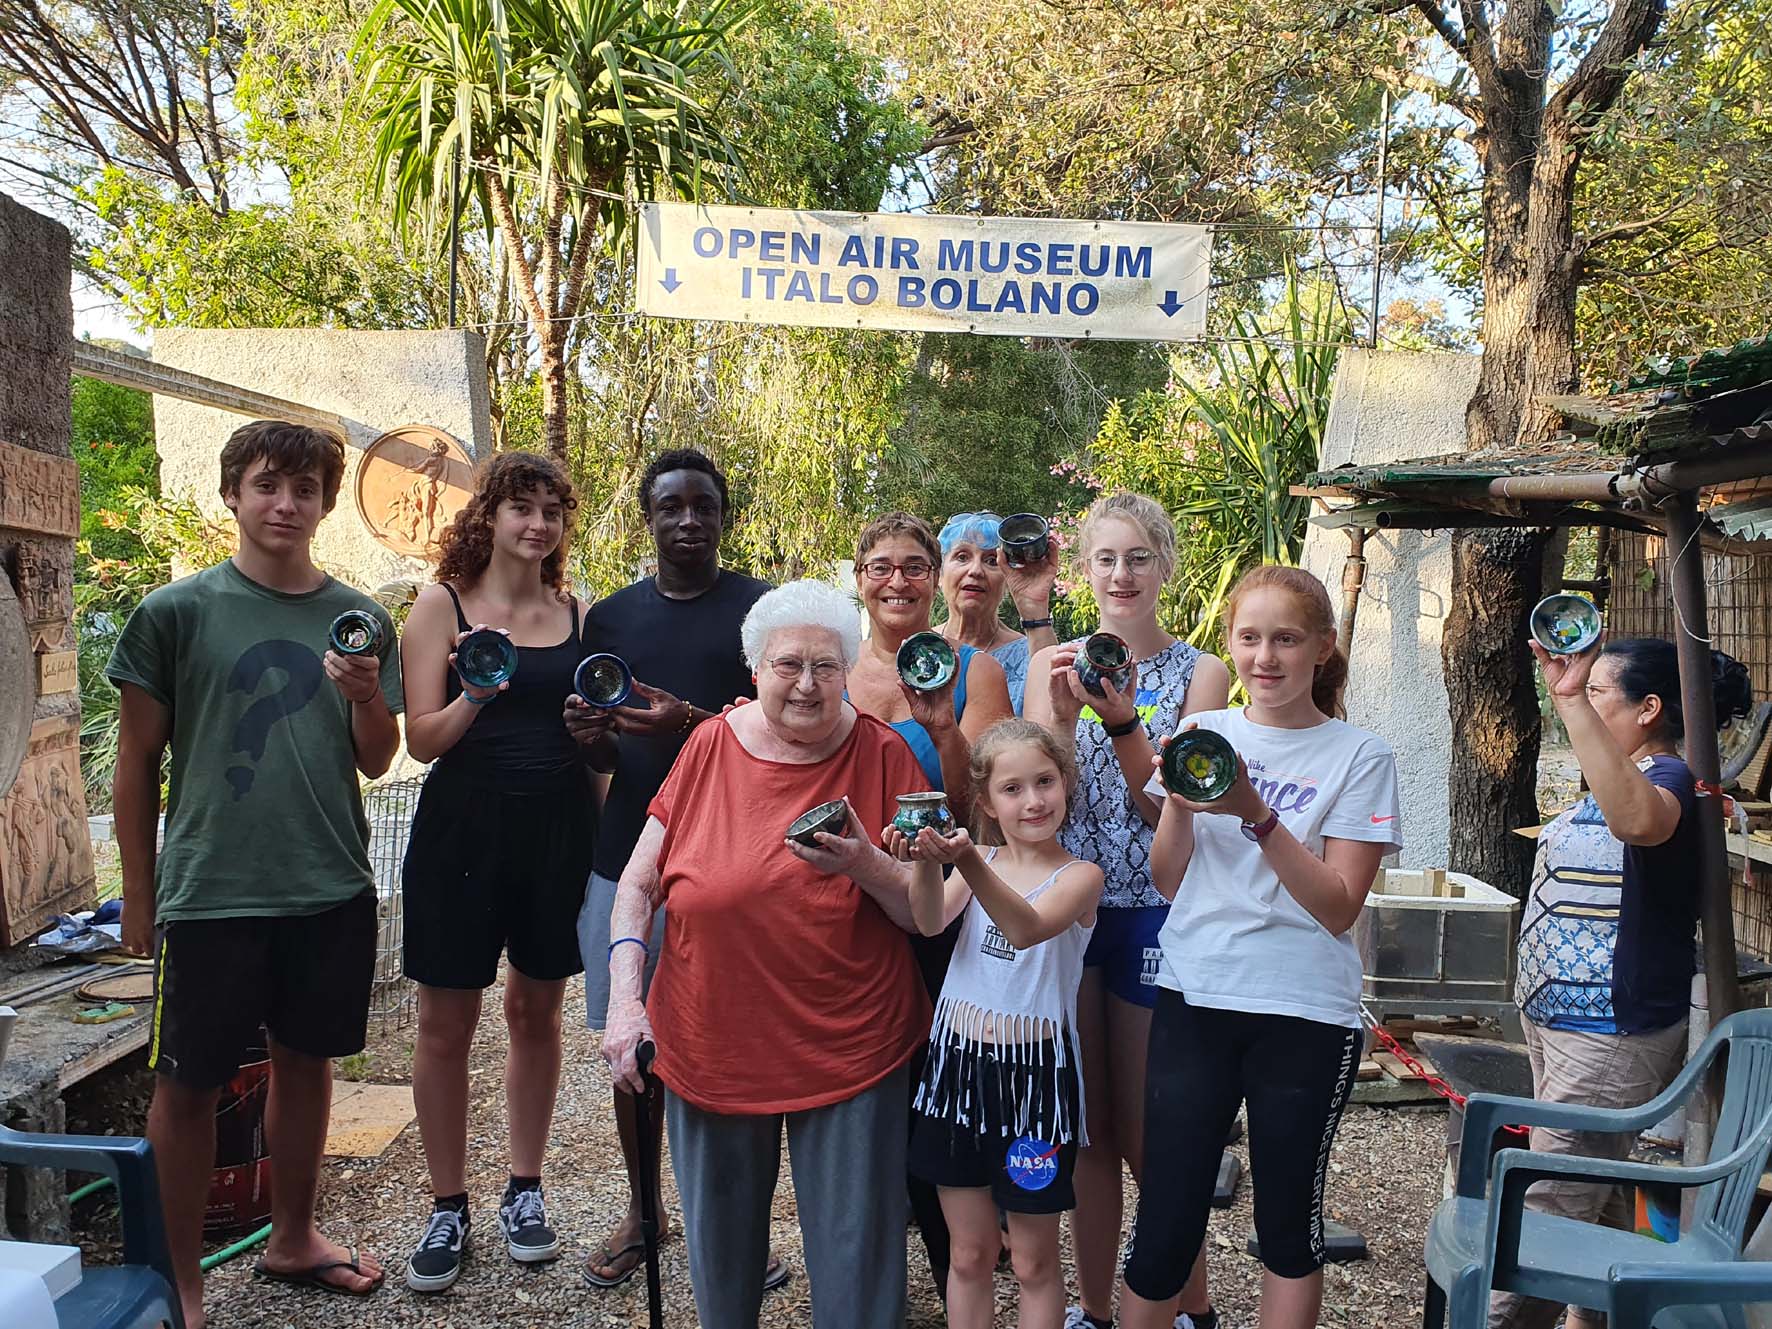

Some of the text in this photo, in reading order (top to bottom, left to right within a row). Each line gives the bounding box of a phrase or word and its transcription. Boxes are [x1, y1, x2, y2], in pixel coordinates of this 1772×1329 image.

[693, 226, 1153, 279] OPEN AIR MUSEUM
[741, 267, 1100, 317] ITALO BOLANO
[1247, 757, 1266, 772] Nike
[1319, 1111, 1338, 1152] NICE
[1009, 1155, 1056, 1169] NASA
